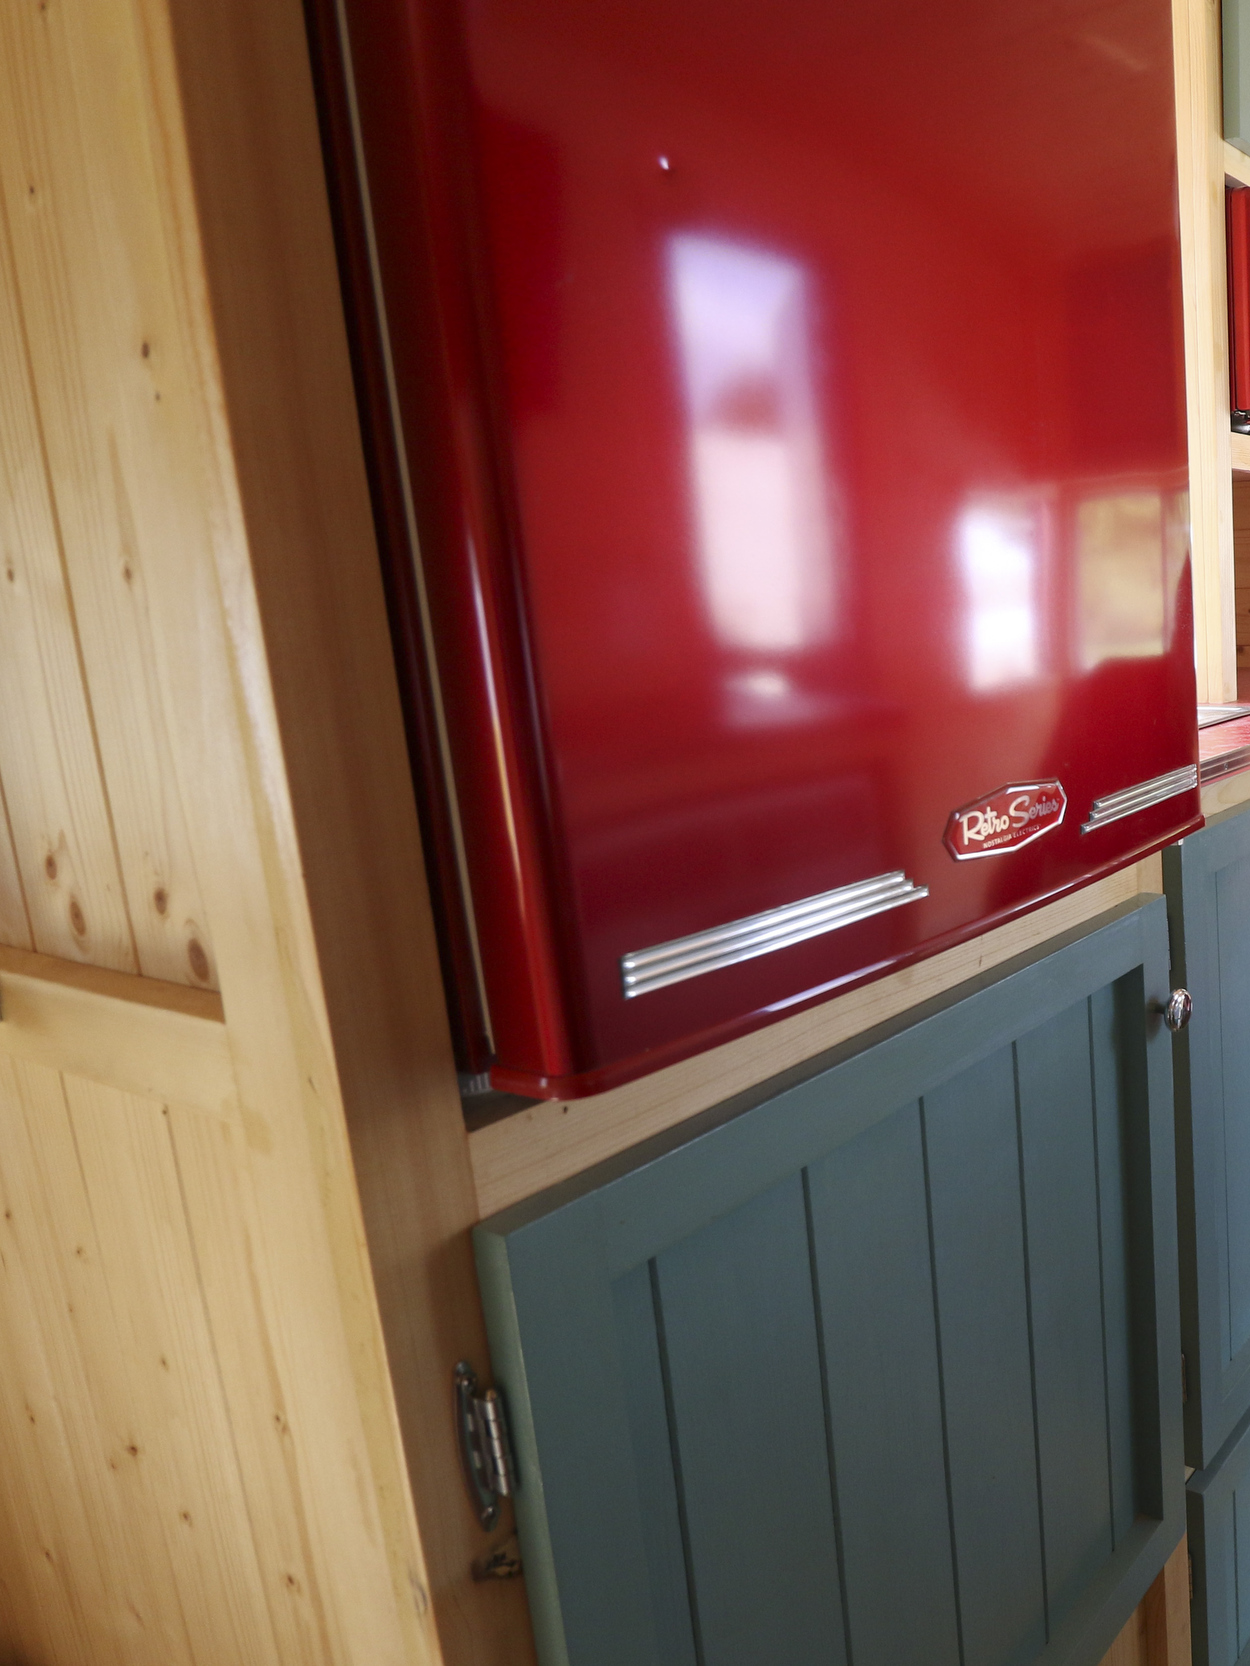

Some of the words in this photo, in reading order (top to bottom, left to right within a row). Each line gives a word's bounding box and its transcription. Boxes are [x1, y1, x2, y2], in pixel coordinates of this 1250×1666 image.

[959, 806, 1010, 846] Retro
[1009, 795, 1059, 828] Series
[982, 834, 1012, 849] NOSTALGIA
